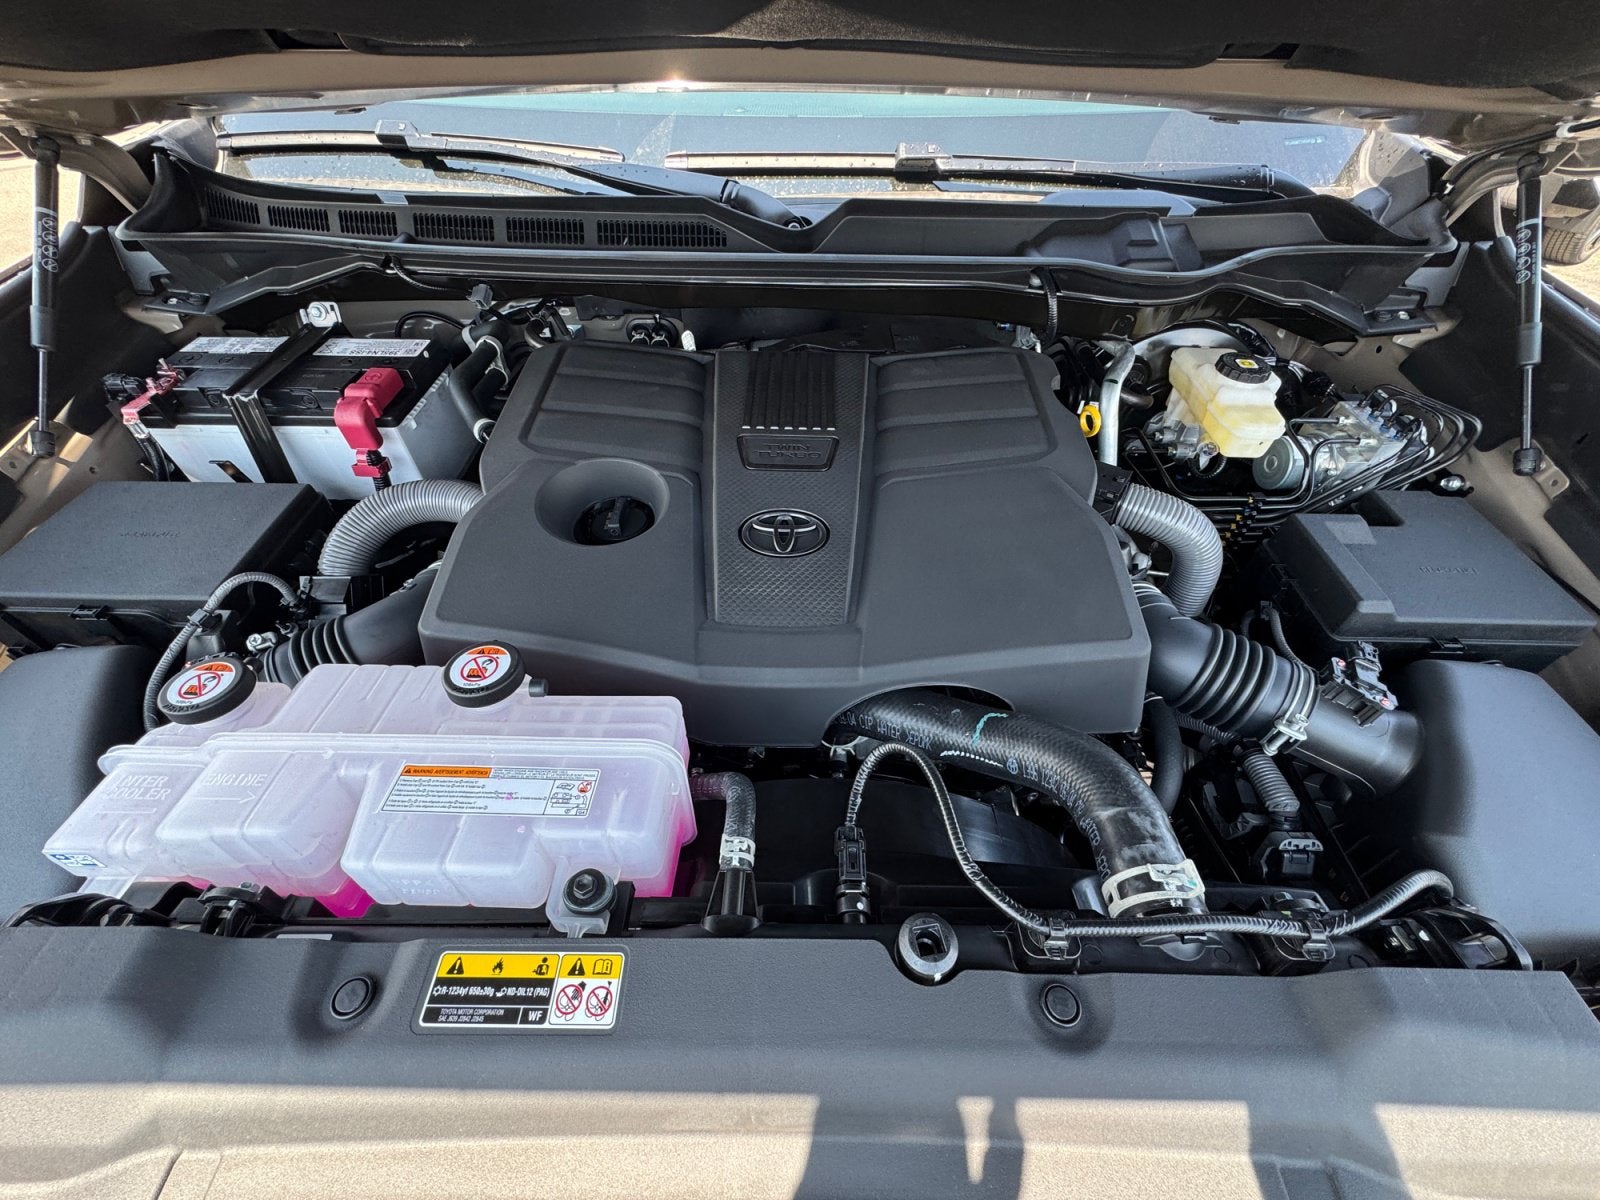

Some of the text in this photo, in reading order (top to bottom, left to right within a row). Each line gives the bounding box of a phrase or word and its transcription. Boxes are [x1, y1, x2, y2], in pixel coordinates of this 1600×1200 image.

[877, 720, 901, 740] WATER
[116, 775, 168, 787] INTER
[202, 774, 267, 786] ENGINE
[105, 787, 171, 800] COOLER
[440, 986, 468, 997] R-1234yf
[528, 1011, 543, 1021] WF
